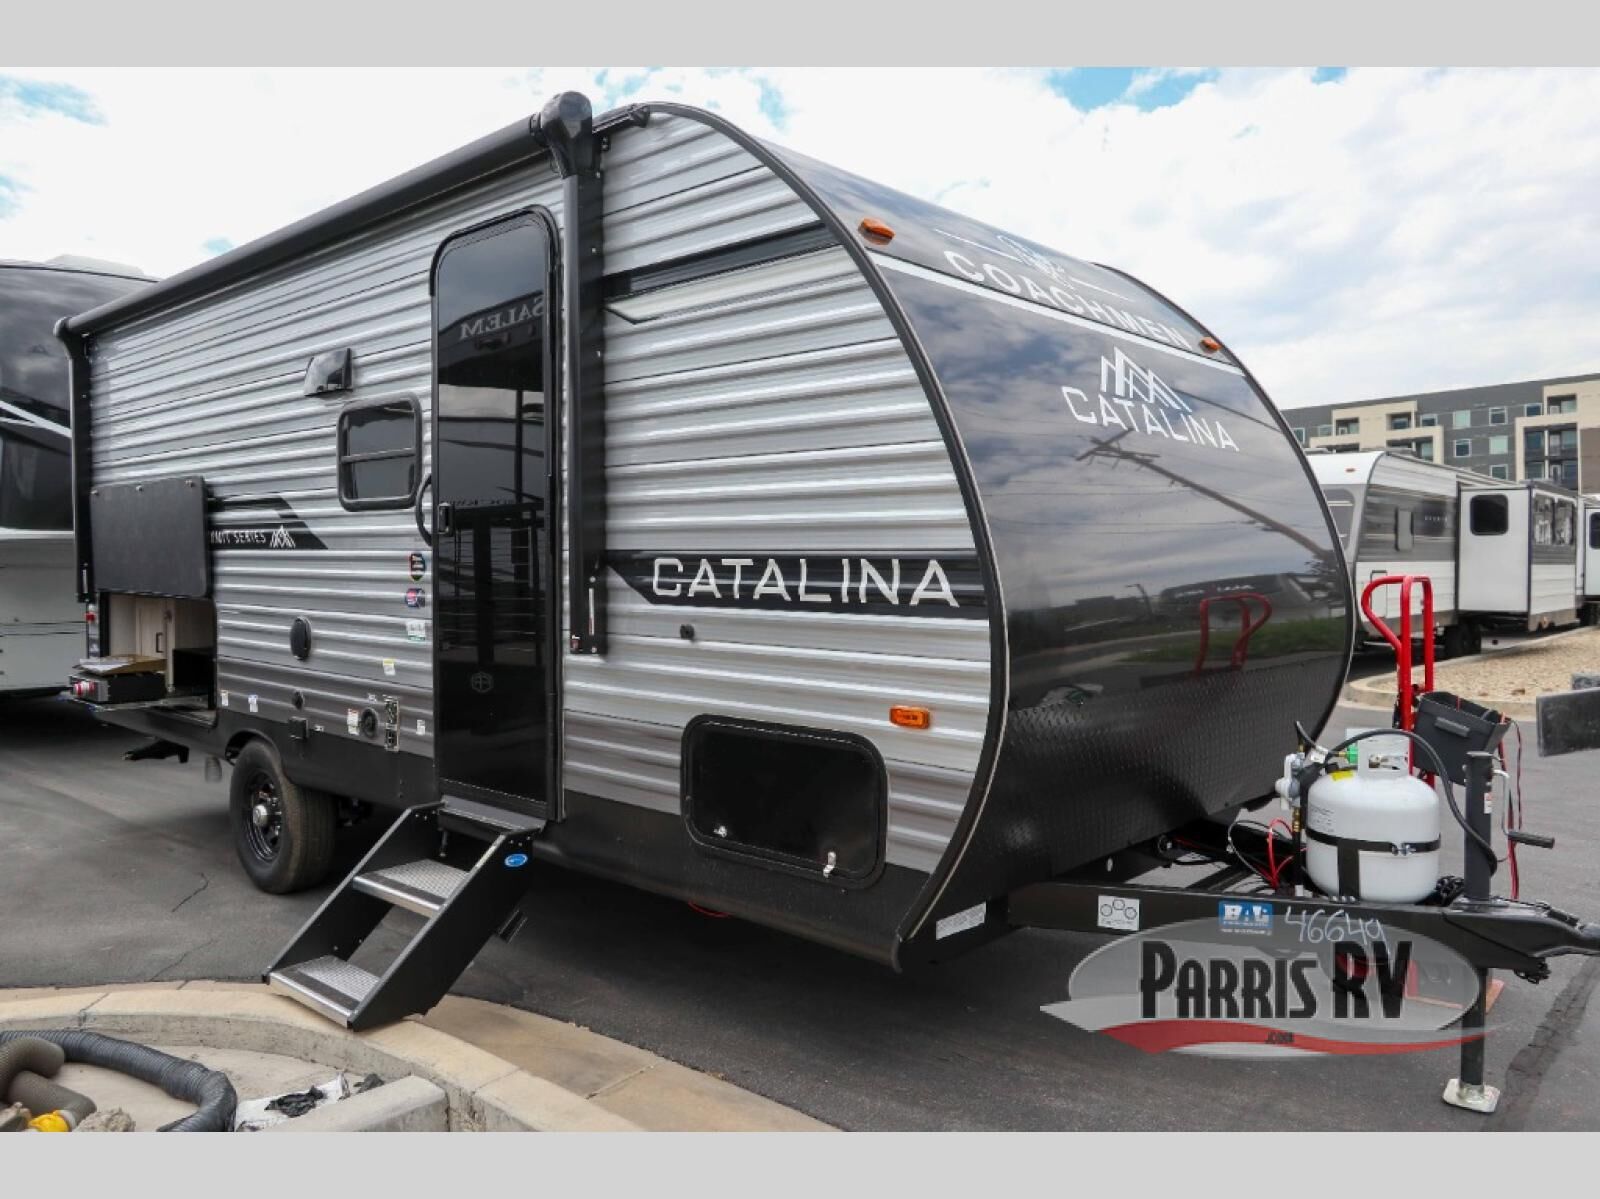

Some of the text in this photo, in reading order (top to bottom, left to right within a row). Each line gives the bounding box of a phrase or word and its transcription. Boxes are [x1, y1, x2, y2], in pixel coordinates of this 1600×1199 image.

[943, 250, 1192, 350] COACHMEN
[1061, 385, 1240, 452] CATALINA
[234, 529, 267, 544] SERIES
[652, 557, 960, 608] CATALINA
[1284, 905, 1391, 957] 46649
